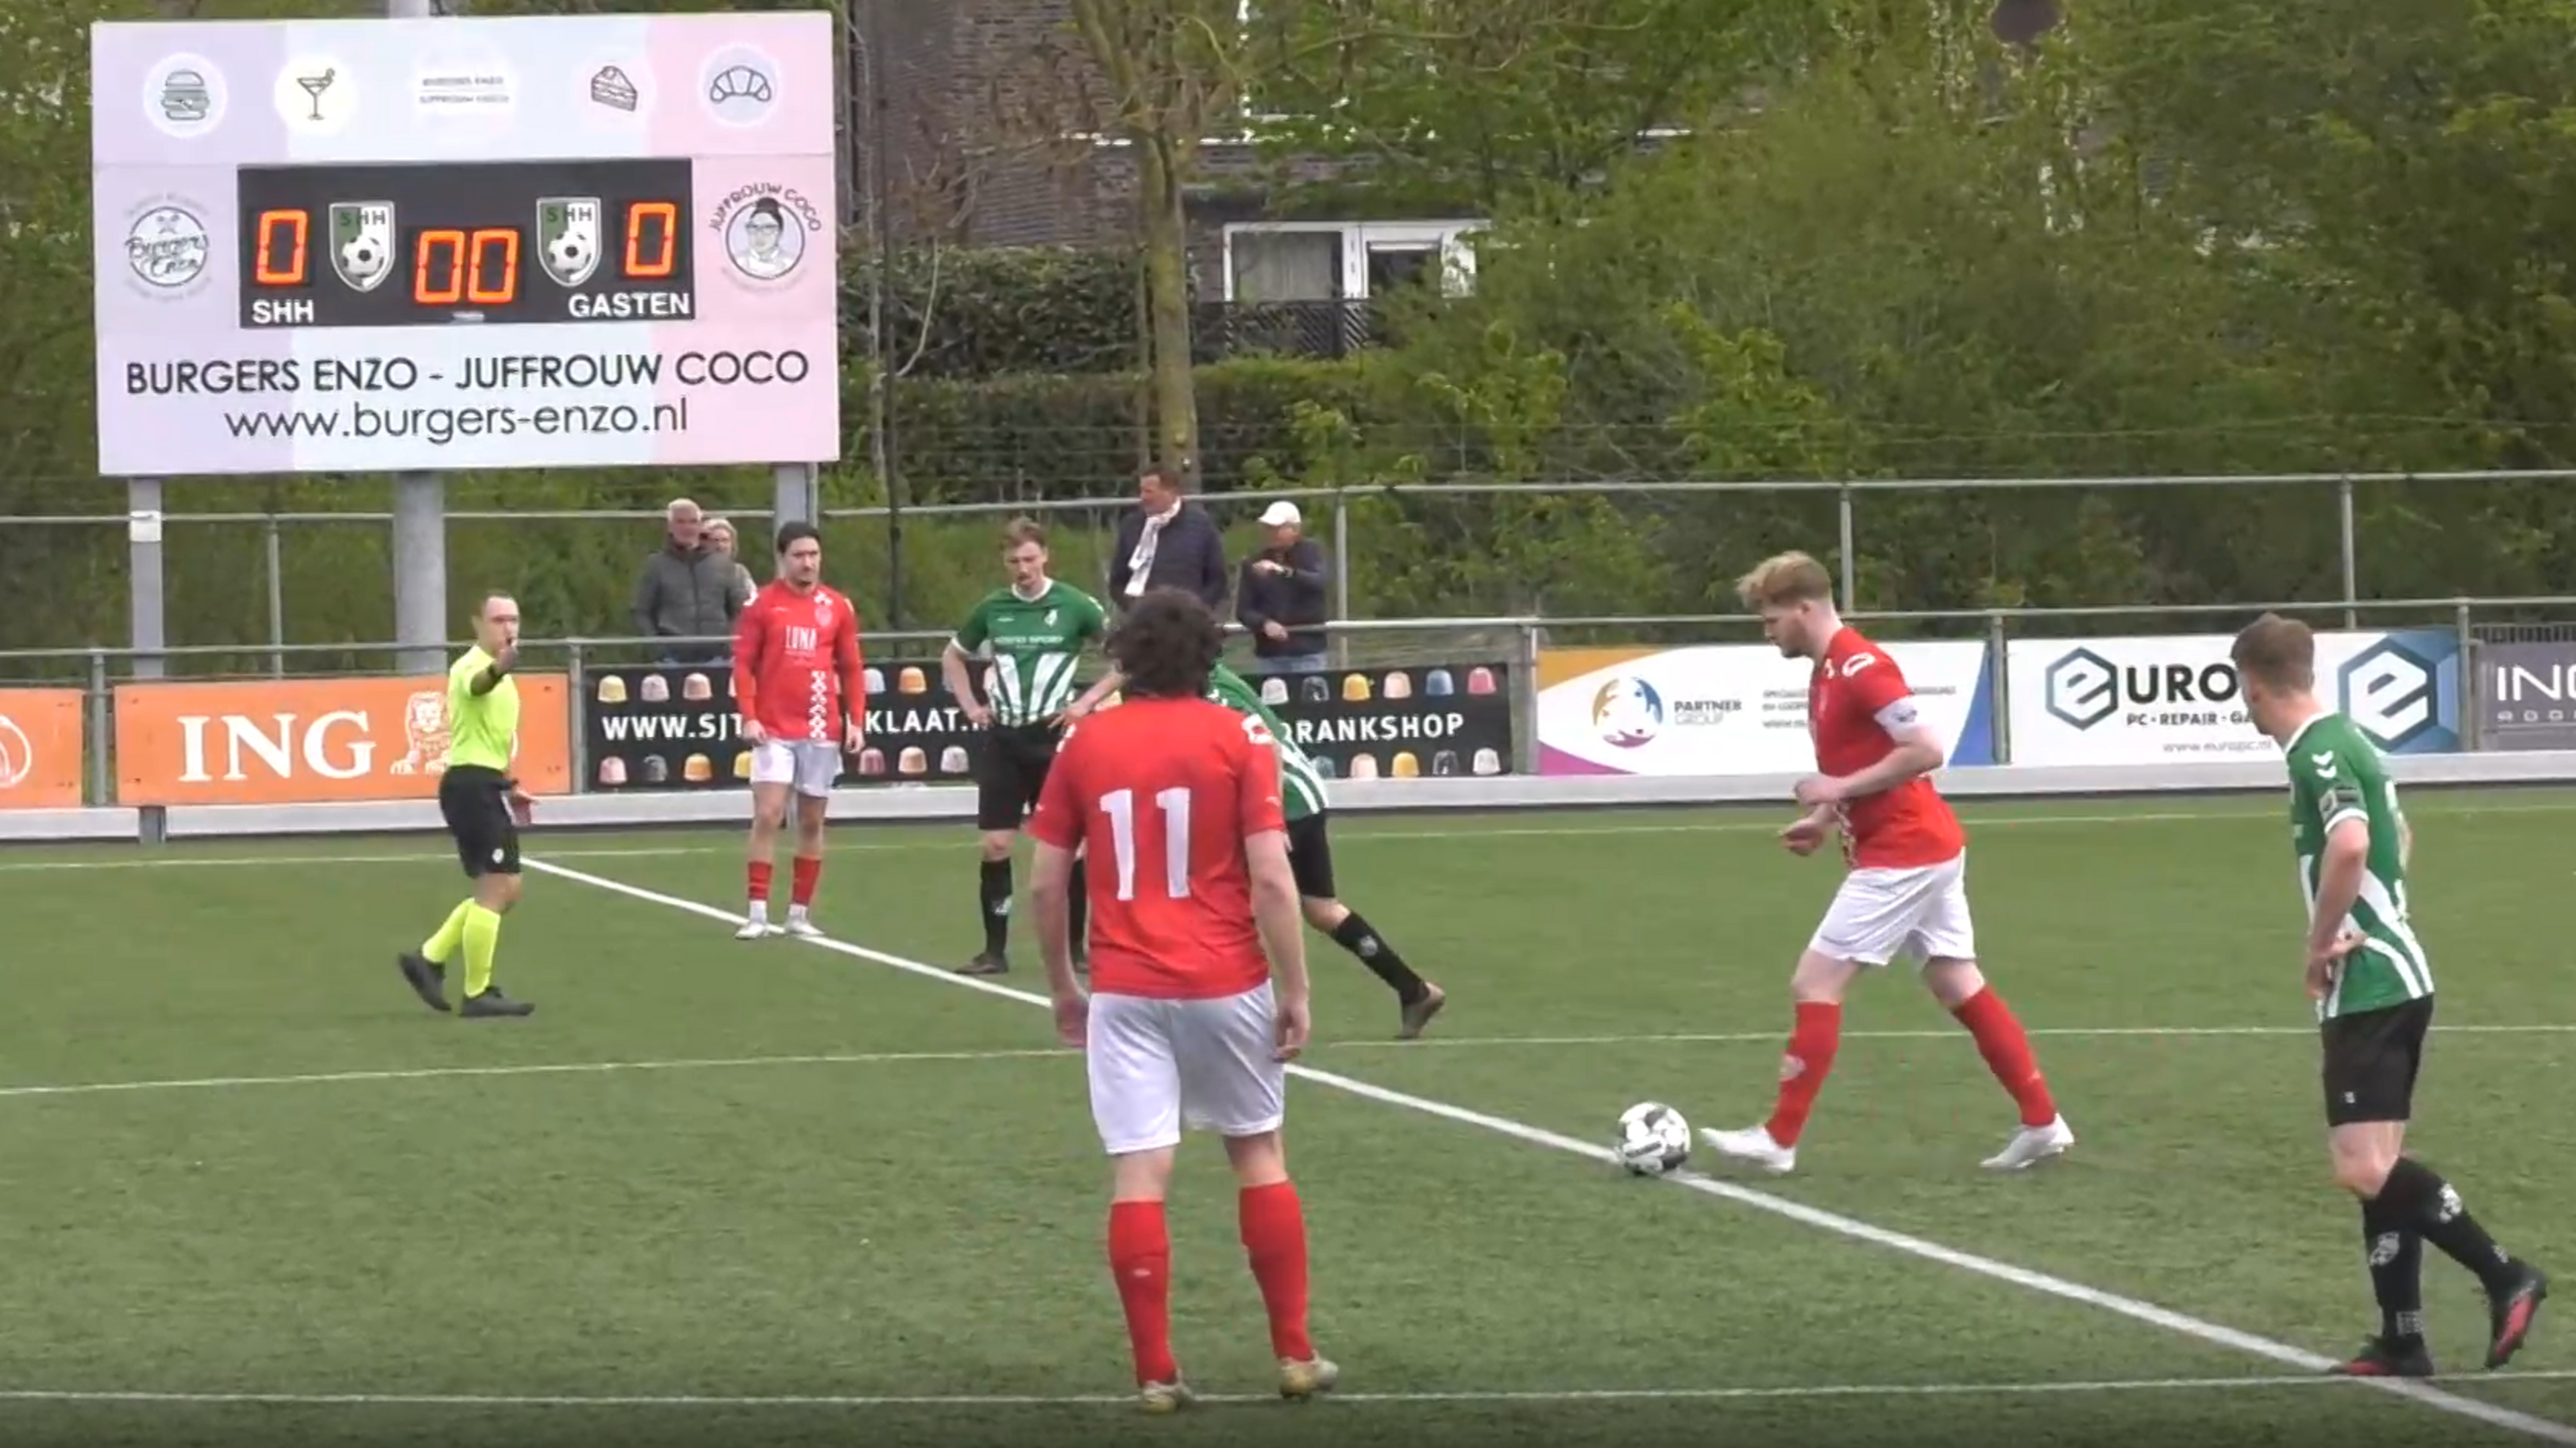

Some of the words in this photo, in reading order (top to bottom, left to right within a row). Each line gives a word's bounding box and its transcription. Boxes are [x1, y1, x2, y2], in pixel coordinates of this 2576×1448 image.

[339, 210, 386, 227] SHH
[546, 206, 592, 222] SHH
[709, 182, 782, 232] JUFFROUW
[784, 188, 822, 231] COCO
[257, 209, 308, 284] 0
[625, 203, 676, 276] 0
[415, 229, 519, 303] 00
[253, 299, 314, 323] SHH
[568, 292, 690, 317] GASTEN
[127, 360, 300, 394] BURGERS
[314, 357, 417, 391] ENZO
[455, 354, 663, 389] JUFFROUW
[676, 350, 808, 385] COCO
[224, 397, 688, 445] www.burgers-enzo.nl
[1674, 700, 1741, 712] PARTNER
[2127, 713, 2147, 726] PC
[2159, 713, 2217, 726] REPAIR
[177, 710, 376, 782] ING
[1099, 787, 1191, 901] 11
